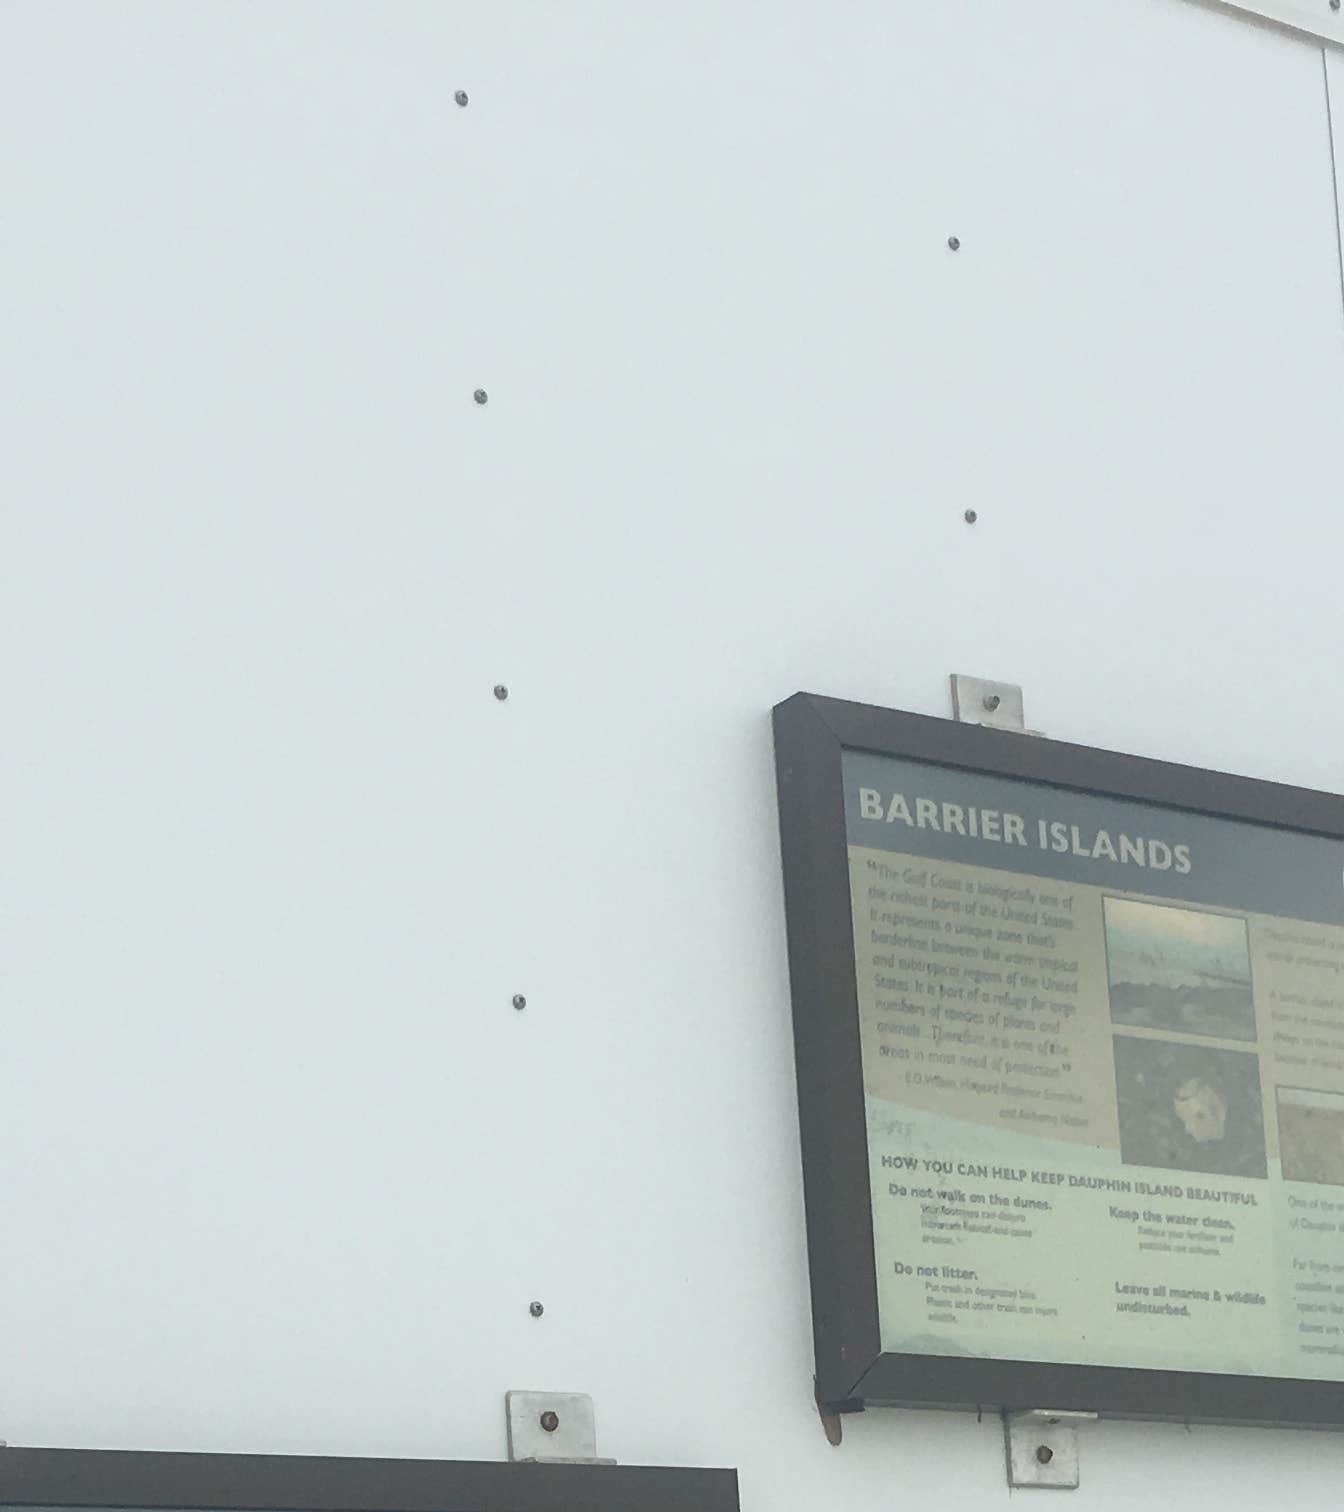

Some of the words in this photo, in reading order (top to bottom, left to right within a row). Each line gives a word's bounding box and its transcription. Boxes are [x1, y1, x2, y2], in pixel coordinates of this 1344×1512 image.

[858, 786, 1028, 846] BARRIER
[1037, 819, 1192, 874] ISLANDS
[880, 1154, 919, 1171] HOW
[921, 1158, 954, 1175] YOU
[955, 1162, 988, 1179] CAN
[991, 1165, 1028, 1182] HELP
[1030, 1170, 1065, 1186] KEEP
[1067, 1174, 1132, 1193] DAUPHIN
[1133, 1181, 1184, 1199] ISLAND
[1185, 1186, 1258, 1207] BEAUTIFUL
[893, 1260, 914, 1276] Do
[915, 1265, 939, 1278] not
[940, 1265, 979, 1281] litter.
